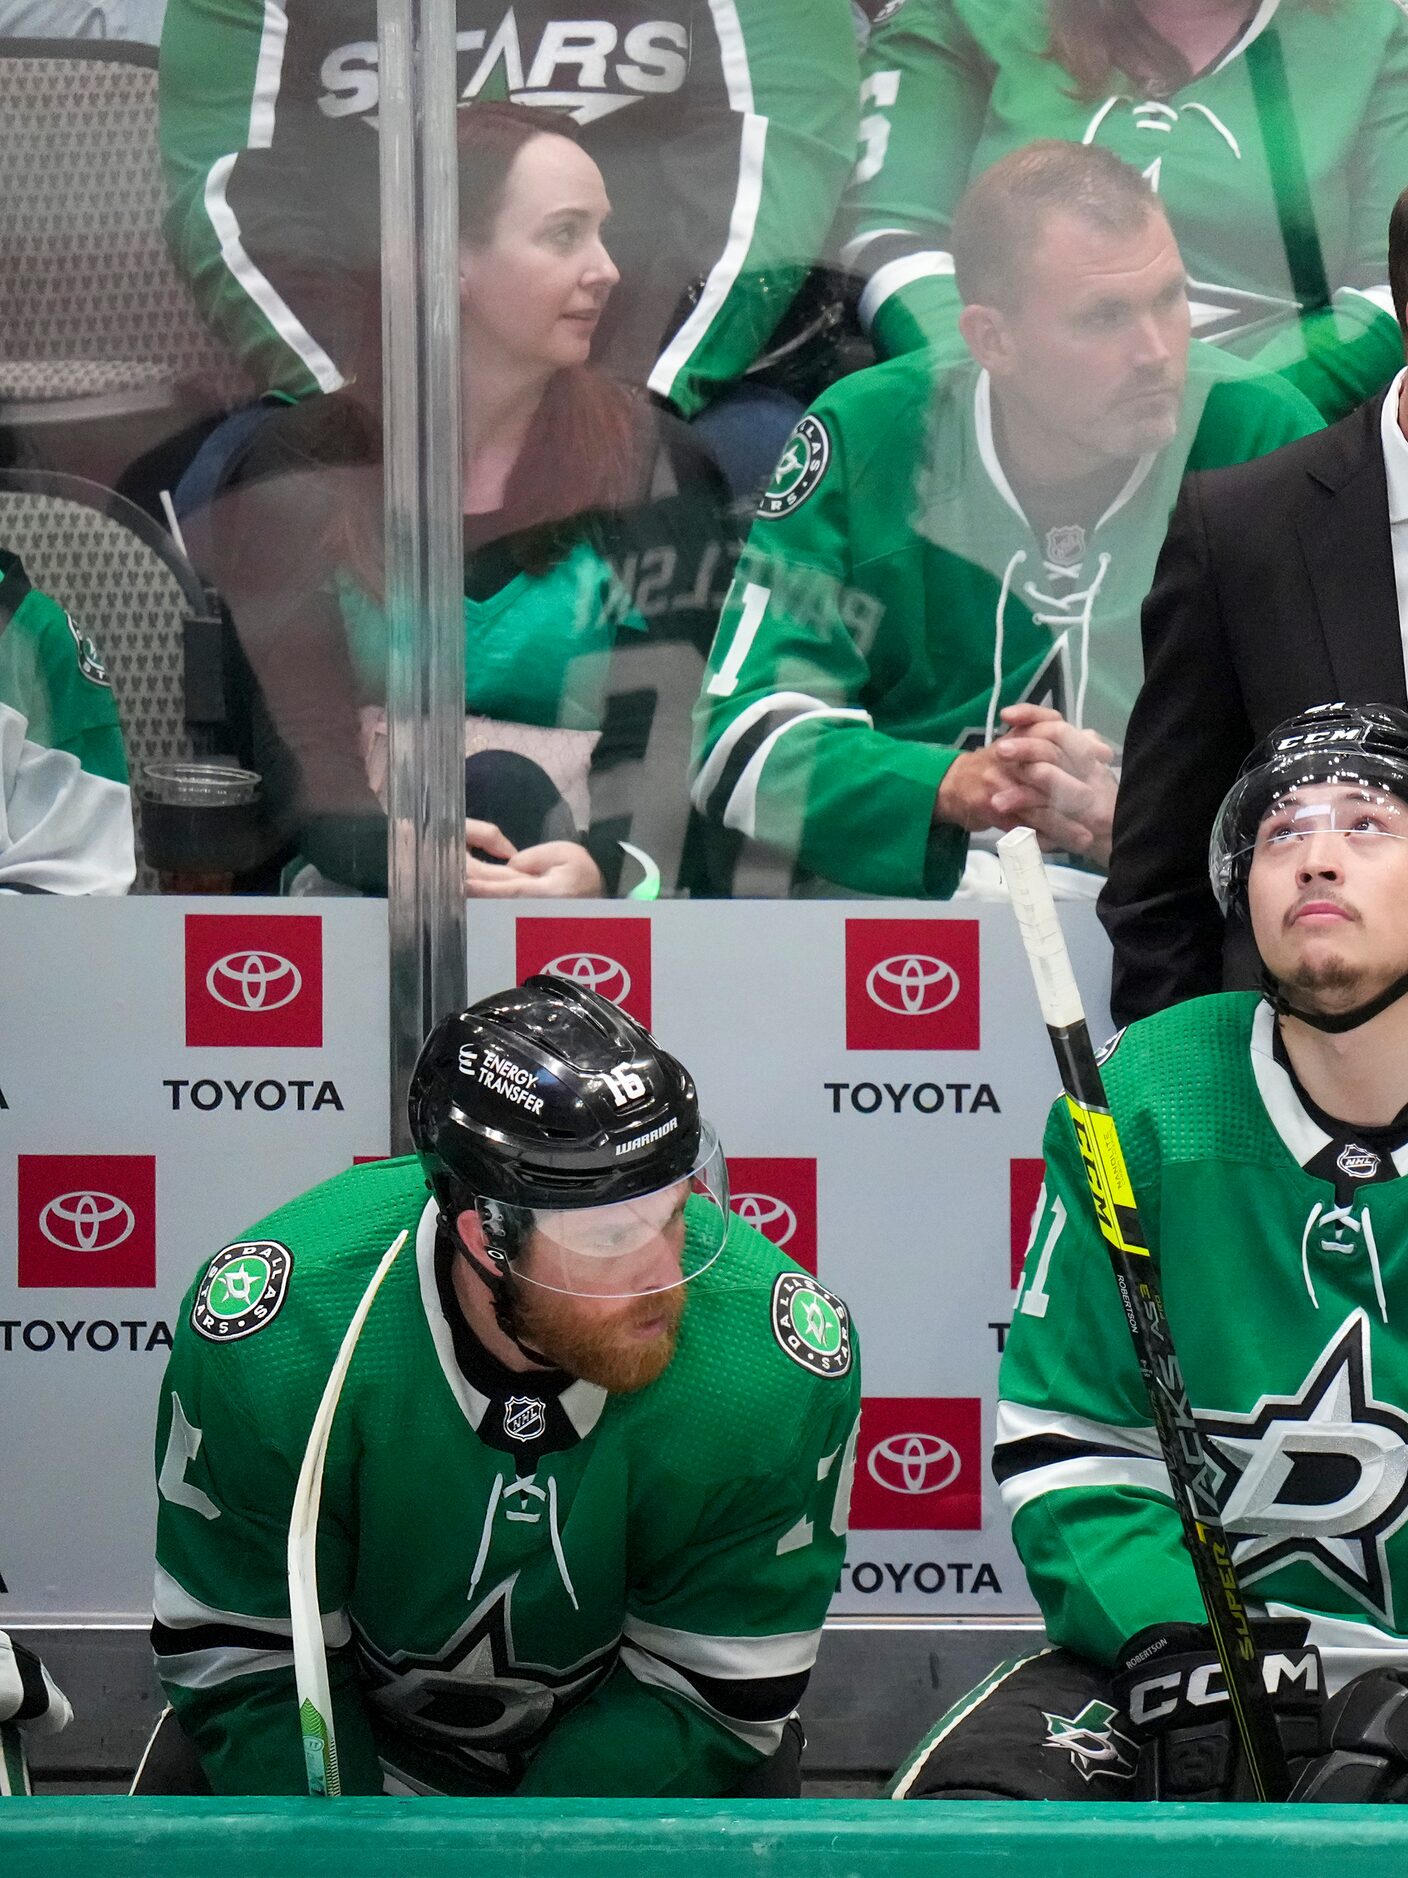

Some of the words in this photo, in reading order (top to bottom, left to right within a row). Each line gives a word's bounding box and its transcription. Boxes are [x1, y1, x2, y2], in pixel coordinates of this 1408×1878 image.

[1277, 729, 1361, 750] CCM
[477, 1067, 545, 1116] TRANSFER
[482, 1051, 539, 1088] ENERGY
[600, 1062, 647, 1107] 16
[163, 1080, 345, 1112] TOYOTA
[824, 1082, 1002, 1114] TOYOTA
[615, 1116, 678, 1156] WARRIOR
[1072, 1117, 1113, 1229] CCM
[196, 1265, 229, 1334] STARS
[242, 1246, 282, 1318] DALLAS
[1117, 1273, 1139, 1334] ROBERTSON
[0, 1319, 173, 1351] TOYOTA
[779, 1279, 816, 1350] DALLAS
[820, 1306, 849, 1370] STARS
[512, 1408, 537, 1431] NHL
[1212, 1541, 1254, 1661] SUPER
[1125, 1637, 1169, 1670] ROBERTSON
[1129, 1653, 1319, 1725] CCM
